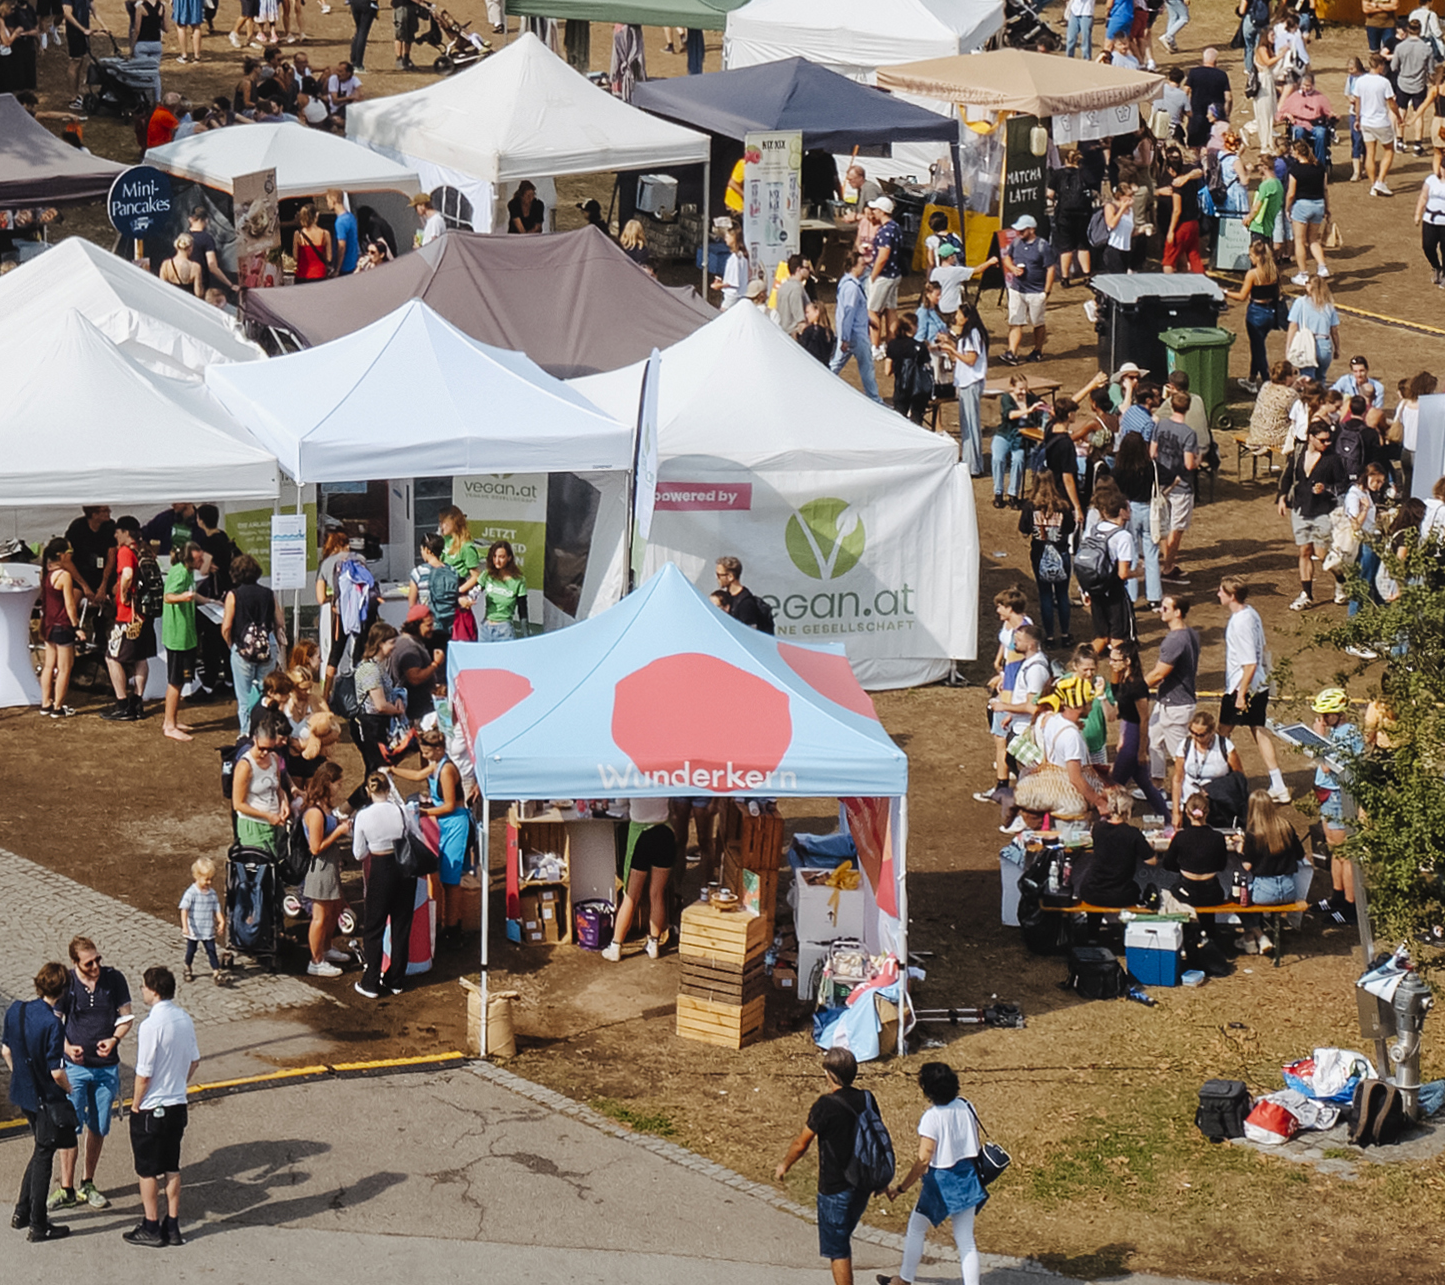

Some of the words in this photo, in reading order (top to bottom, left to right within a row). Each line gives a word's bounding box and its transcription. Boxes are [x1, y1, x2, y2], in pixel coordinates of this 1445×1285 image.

[1007, 166, 1042, 186] MATCHA
[122, 179, 160, 199] Mini-
[1009, 186, 1038, 204] LATTE
[112, 197, 171, 218] Pancakes
[463, 480, 538, 500] vegan.at
[654, 489, 717, 504] powered
[718, 489, 739, 505] by
[481, 526, 518, 540] JETZT
[762, 583, 915, 620] egan.at
[802, 620, 915, 636] GESELLSCHAFT
[596, 761, 798, 791] Wunderkern
